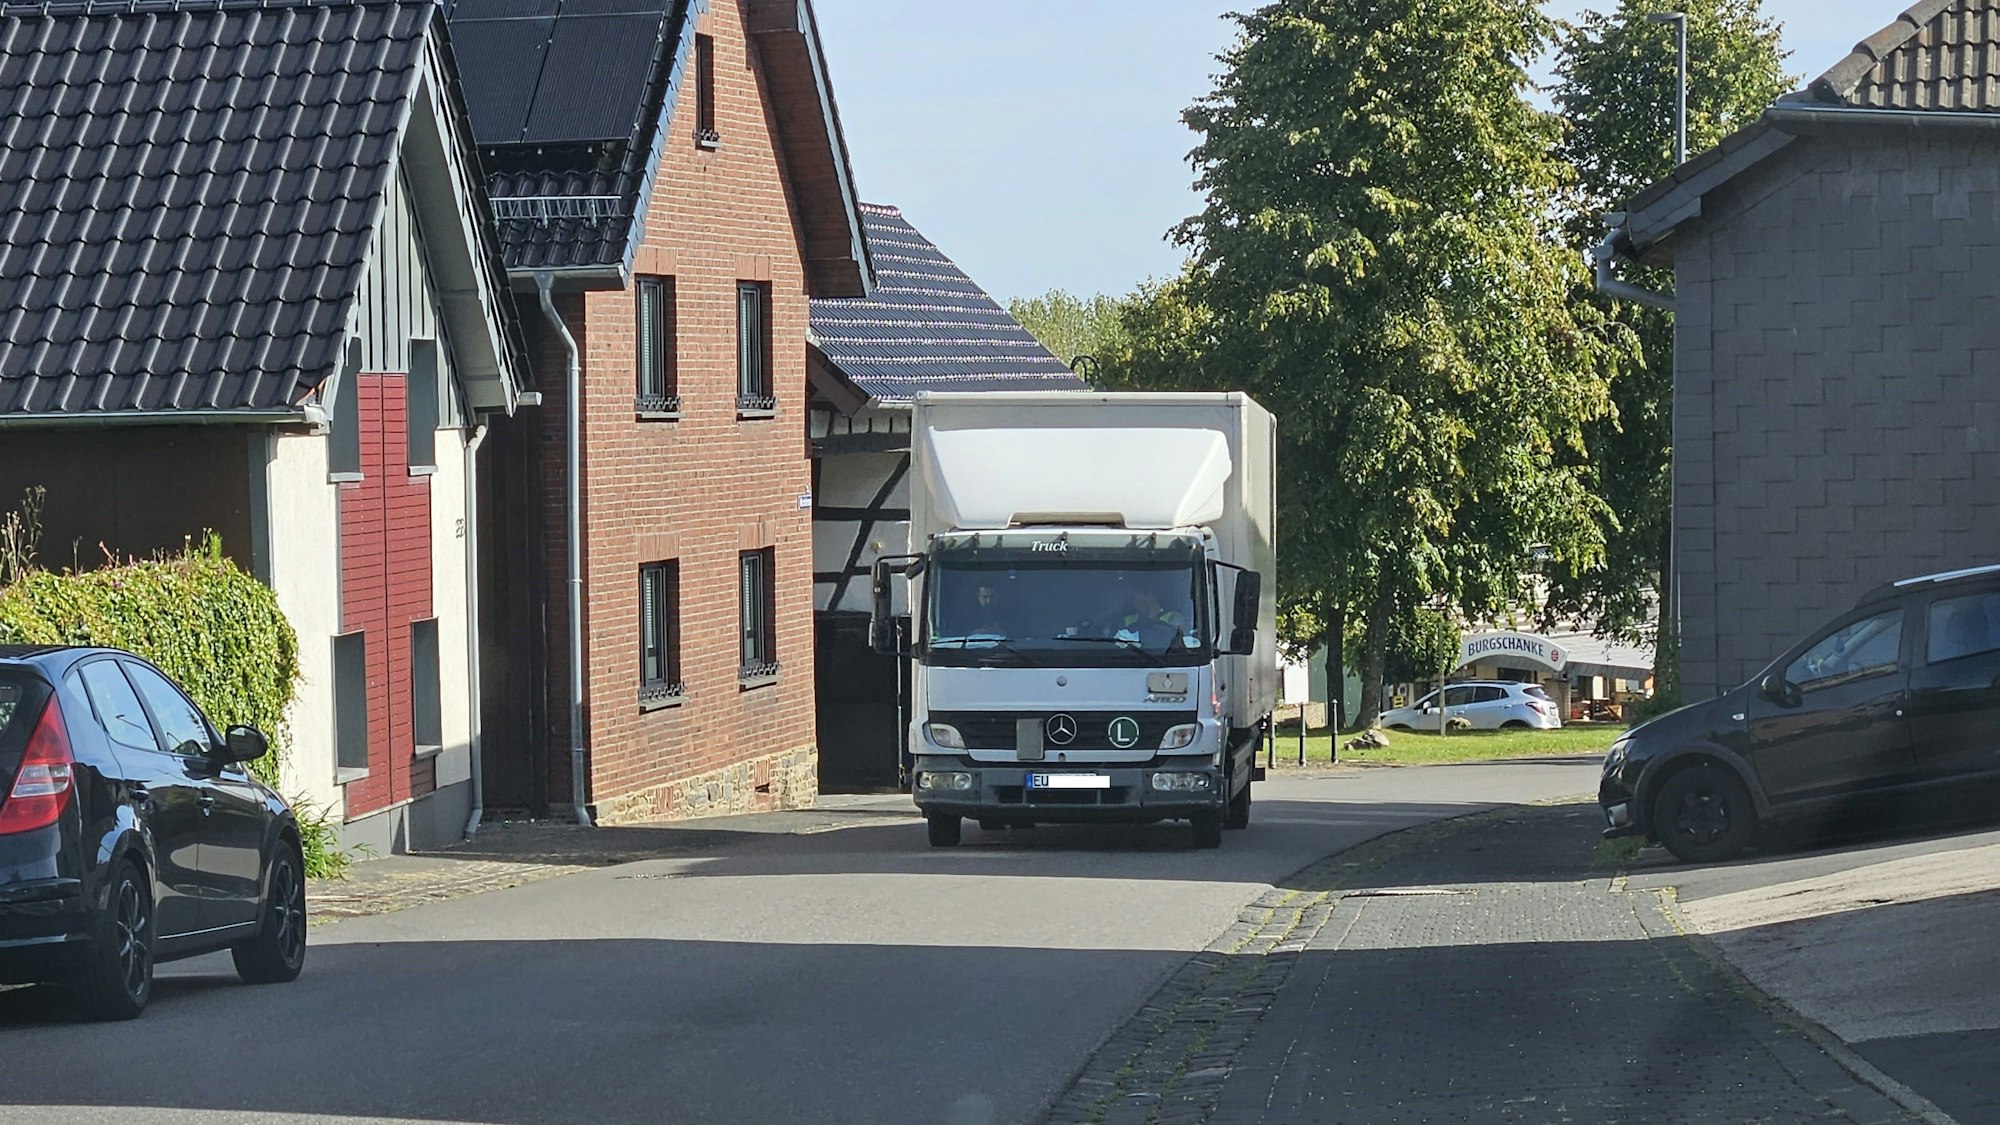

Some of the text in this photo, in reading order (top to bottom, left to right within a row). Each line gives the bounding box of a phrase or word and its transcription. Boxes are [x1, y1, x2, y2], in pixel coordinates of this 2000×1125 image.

[1031, 540, 1068, 552] Truck
[1117, 723, 1130, 742] L
[1033, 775, 1049, 787] EU
